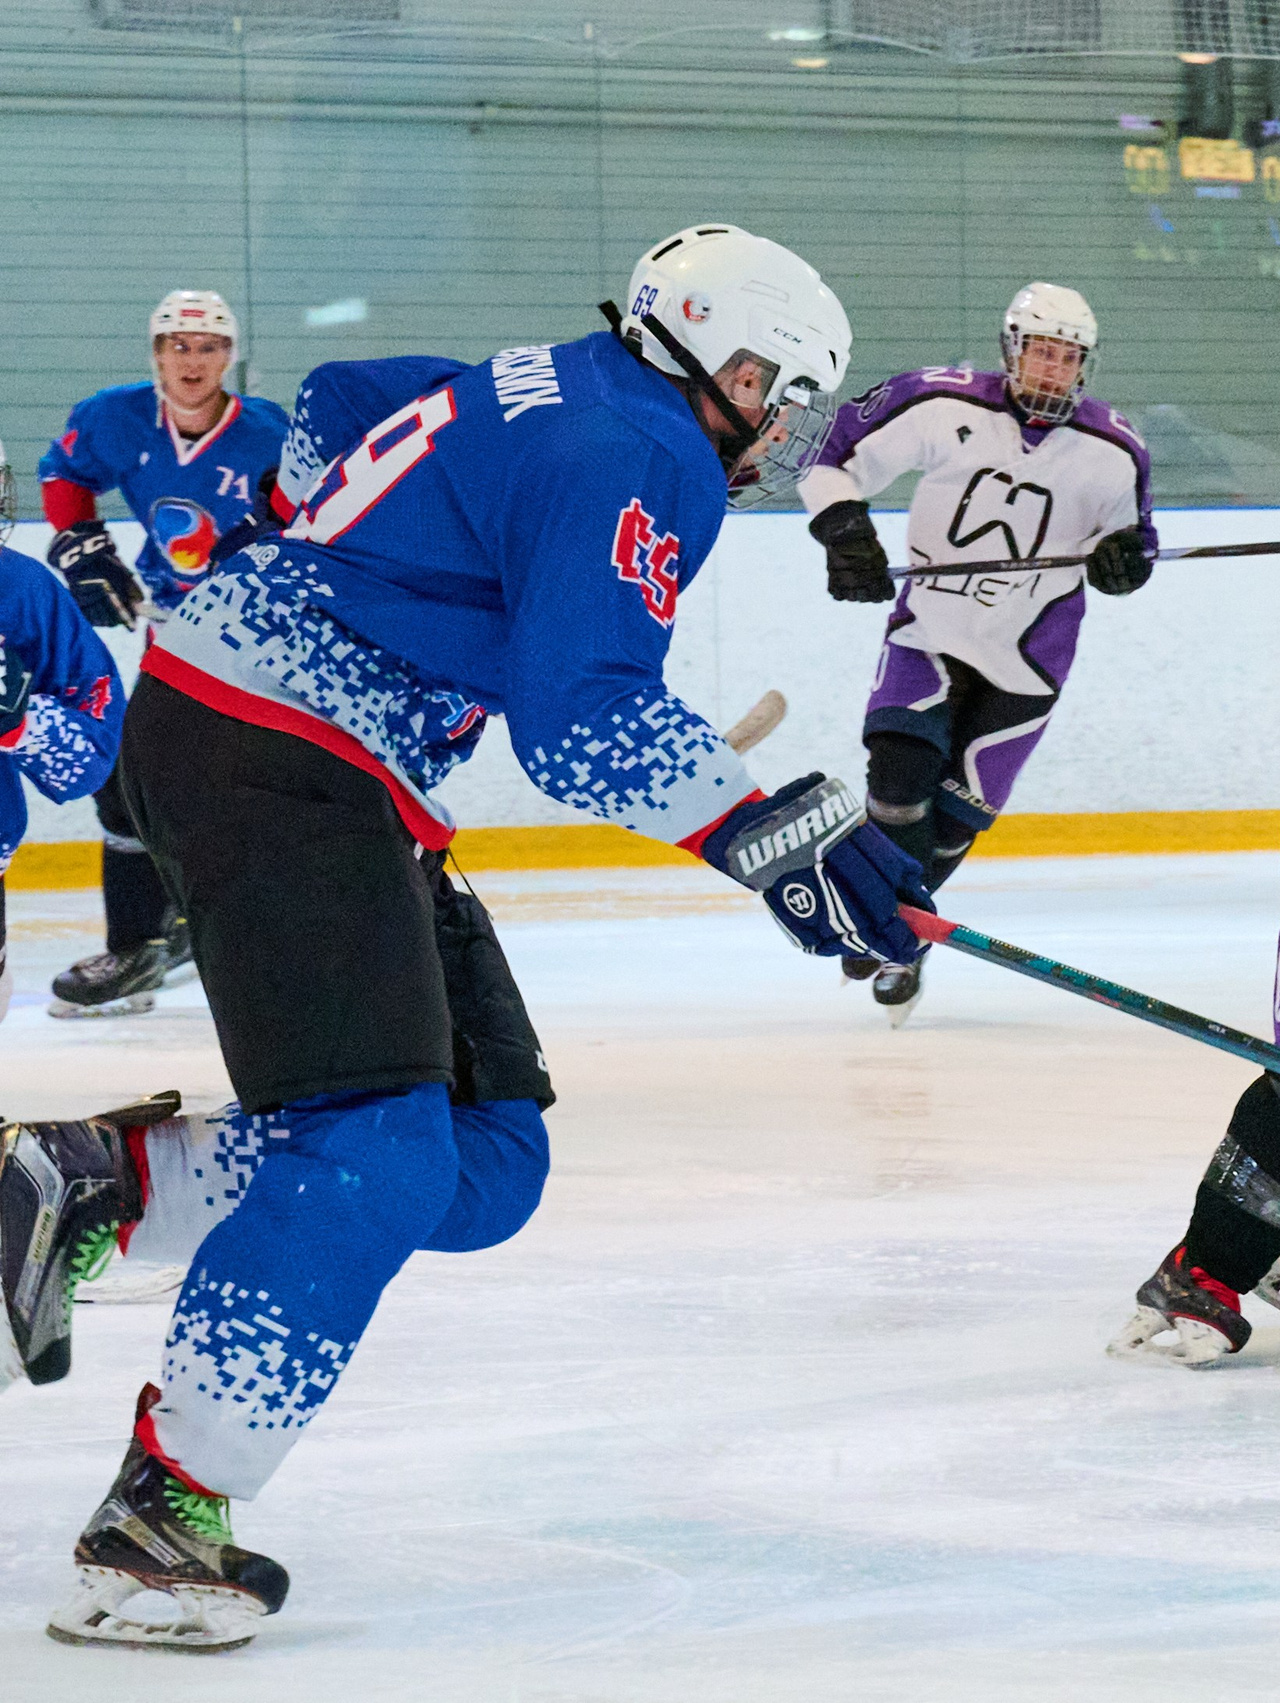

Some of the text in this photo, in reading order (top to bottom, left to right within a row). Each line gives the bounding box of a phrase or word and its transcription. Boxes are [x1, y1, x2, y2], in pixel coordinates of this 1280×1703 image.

[631, 284, 658, 318] 69
[773, 327, 803, 344] CCM
[215, 465, 252, 505] 71
[60, 534, 112, 570] CC
[737, 787, 859, 877] WARRI
